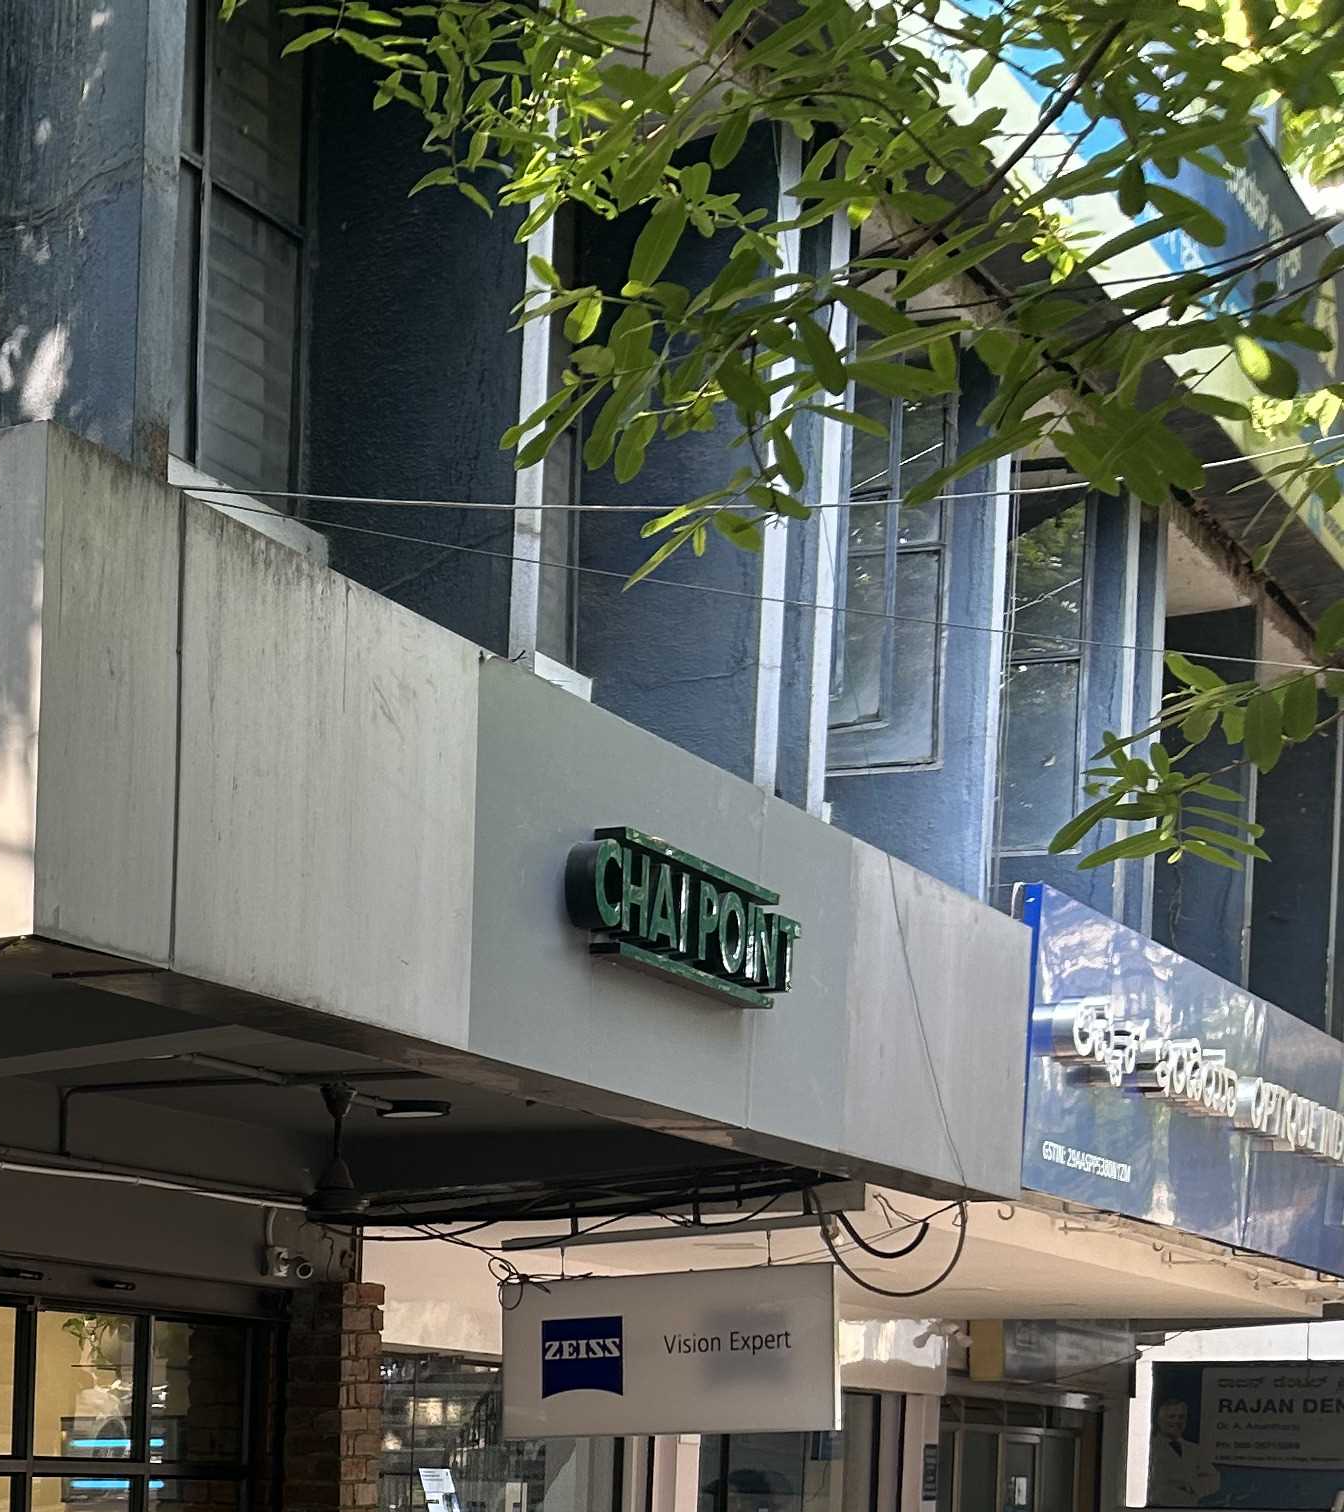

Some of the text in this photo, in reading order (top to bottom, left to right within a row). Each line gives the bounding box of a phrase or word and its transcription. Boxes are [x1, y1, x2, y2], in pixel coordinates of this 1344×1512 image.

[586, 838, 802, 993] CHAI POINT
[544, 1337, 621, 1361] ZEISS
[663, 1330, 793, 1356] Vision Expert
[1217, 1398, 1295, 1414] RAJAN
